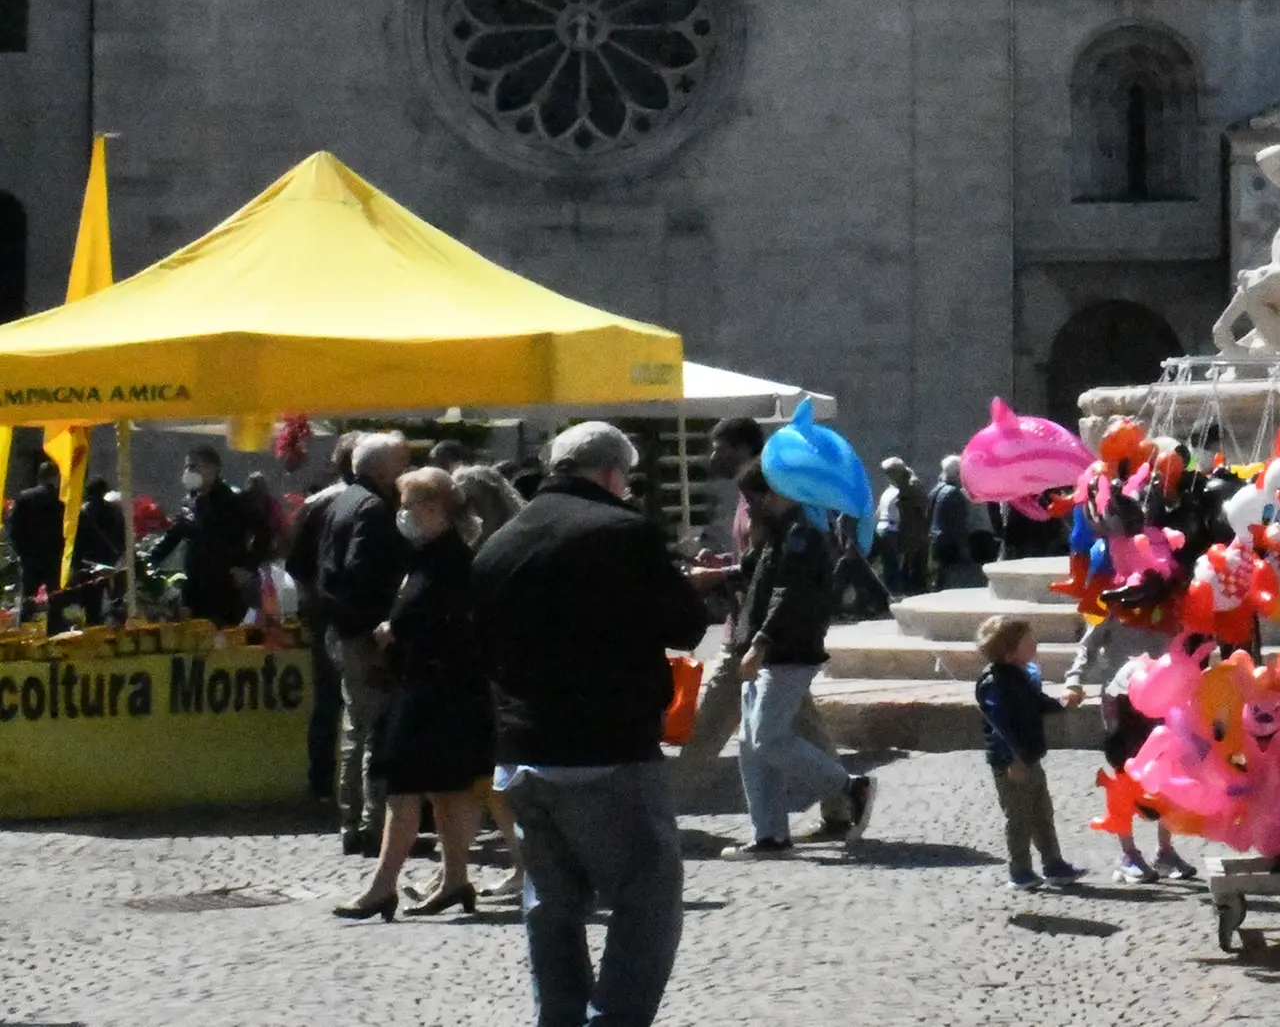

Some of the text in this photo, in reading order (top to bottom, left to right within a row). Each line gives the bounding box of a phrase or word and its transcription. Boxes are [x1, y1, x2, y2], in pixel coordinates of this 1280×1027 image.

[0, 384, 190, 406] MPAGNA AMICA
[170, 654, 303, 713] Monte
